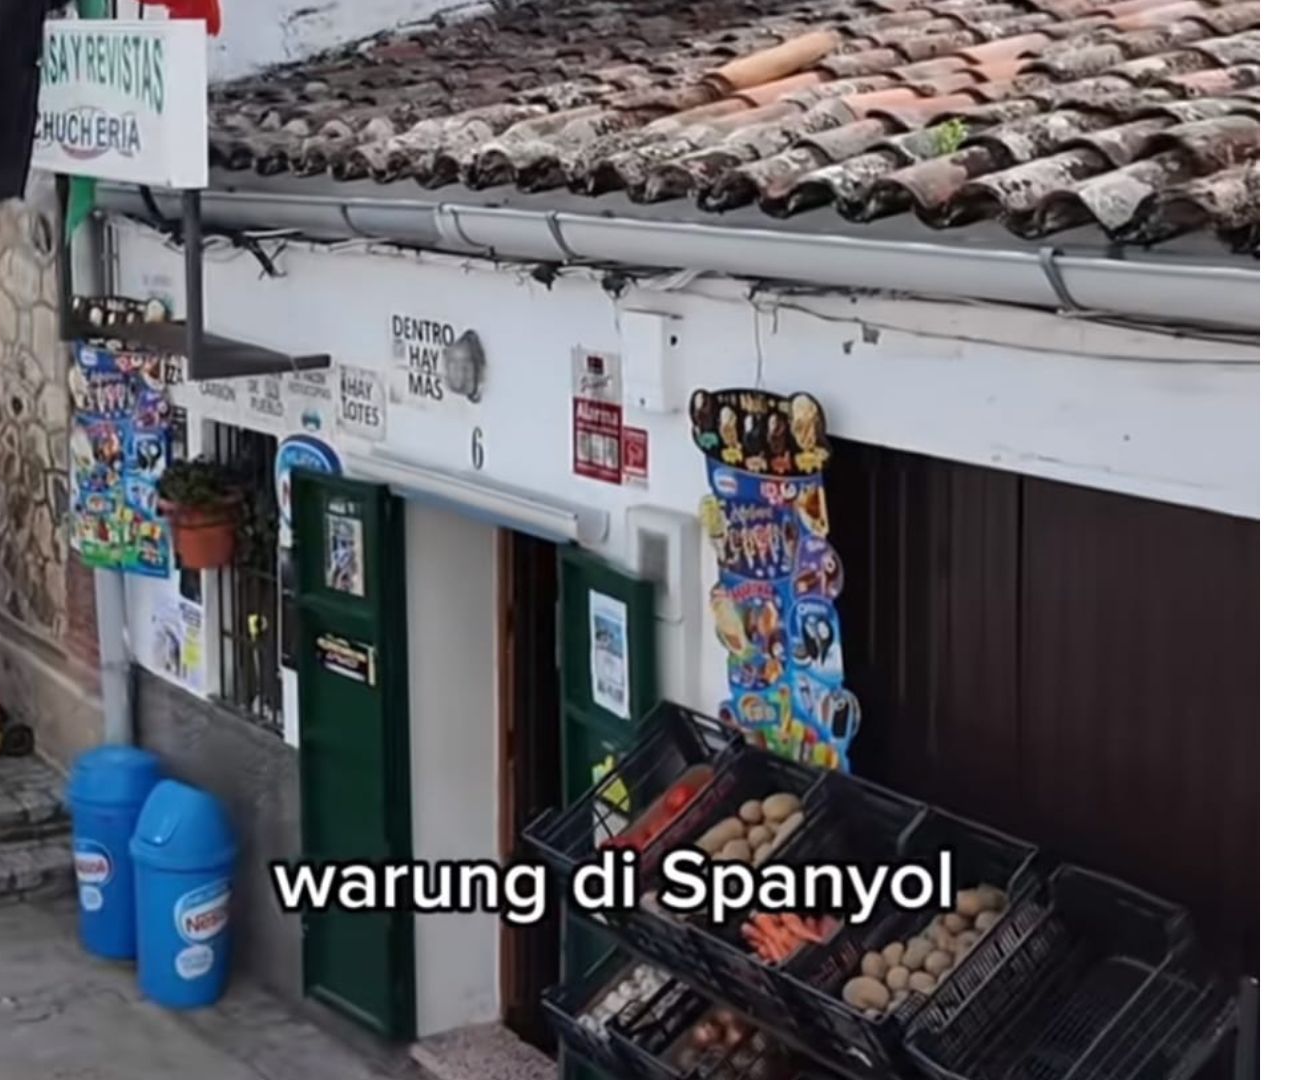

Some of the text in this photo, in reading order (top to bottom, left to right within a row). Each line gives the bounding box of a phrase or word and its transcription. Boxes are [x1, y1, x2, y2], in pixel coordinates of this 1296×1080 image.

[70, 34, 81, 82] Y
[86, 34, 164, 116] REVISTAS
[392, 314, 455, 347] DENTRO
[409, 346, 440, 373] HAY
[347, 377, 373, 401] HAY
[343, 396, 380, 427] LOTES
[471, 426, 484, 470] 6
